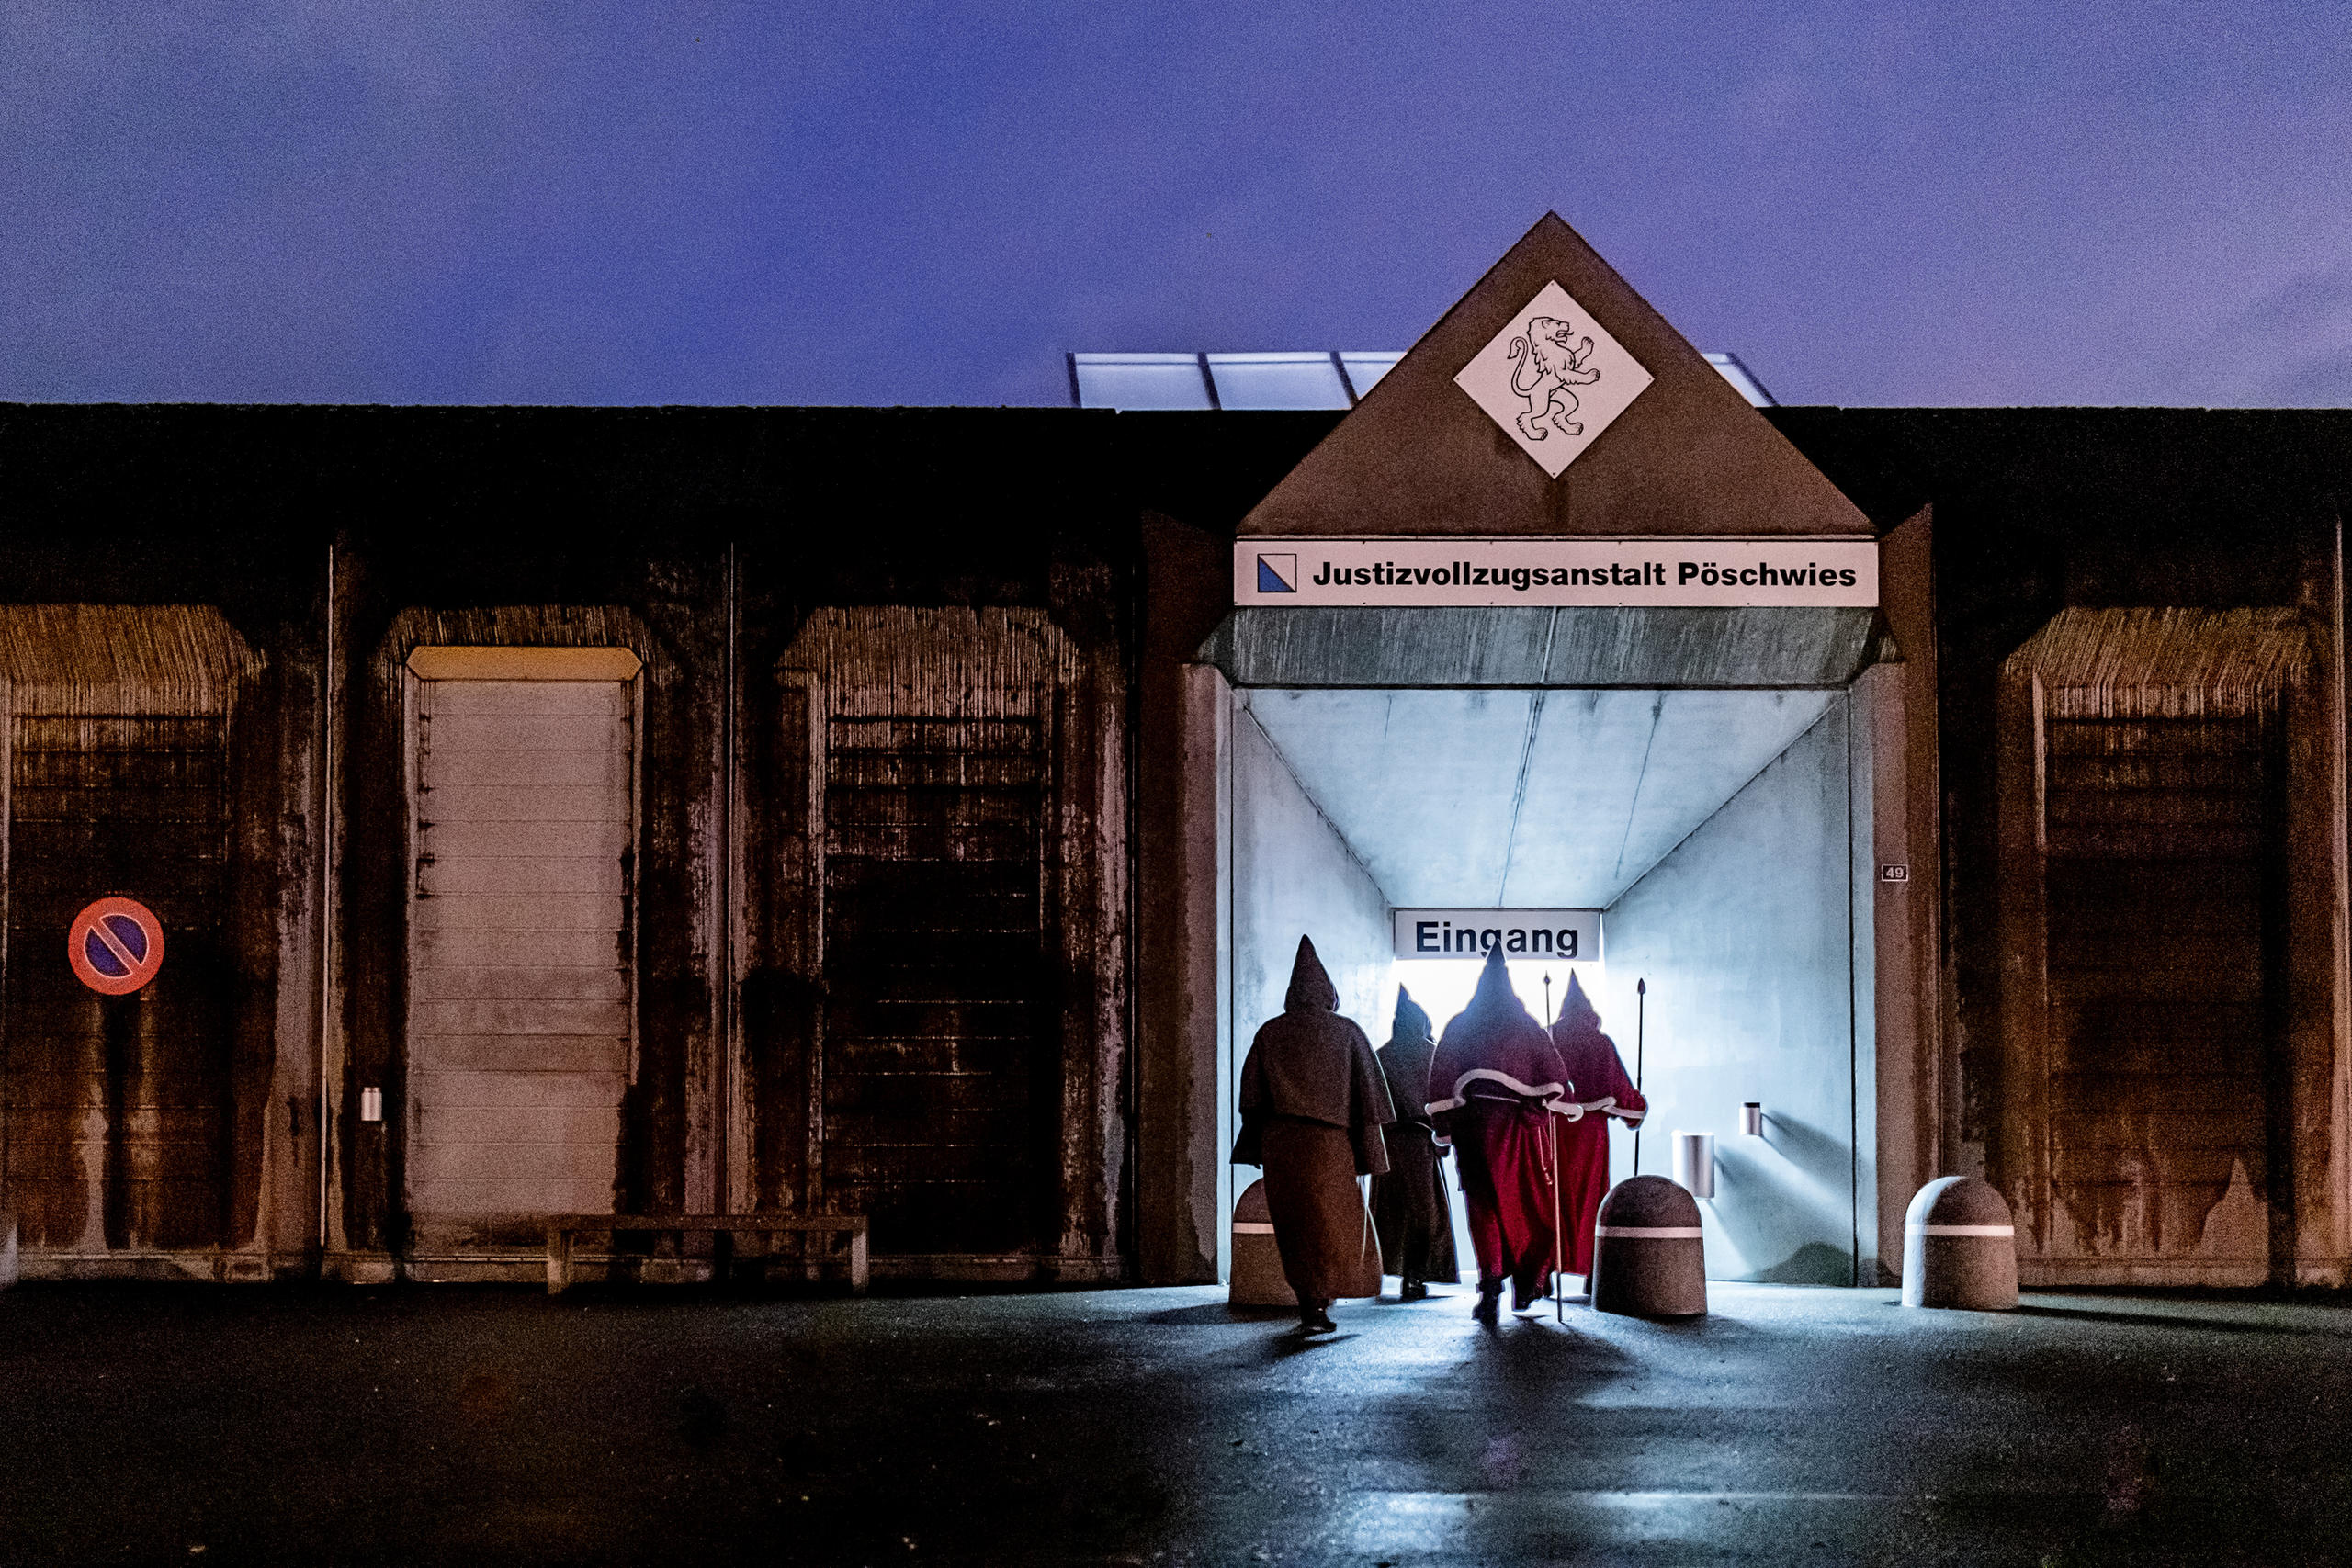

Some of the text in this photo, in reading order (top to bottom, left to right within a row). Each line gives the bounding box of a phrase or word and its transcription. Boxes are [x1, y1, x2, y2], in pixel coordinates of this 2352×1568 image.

[1312, 560, 1857, 592] Justizvollzugsanstalt Pöschwies
[1885, 866, 1905, 879] 49
[1416, 920, 1579, 959] Eingang
